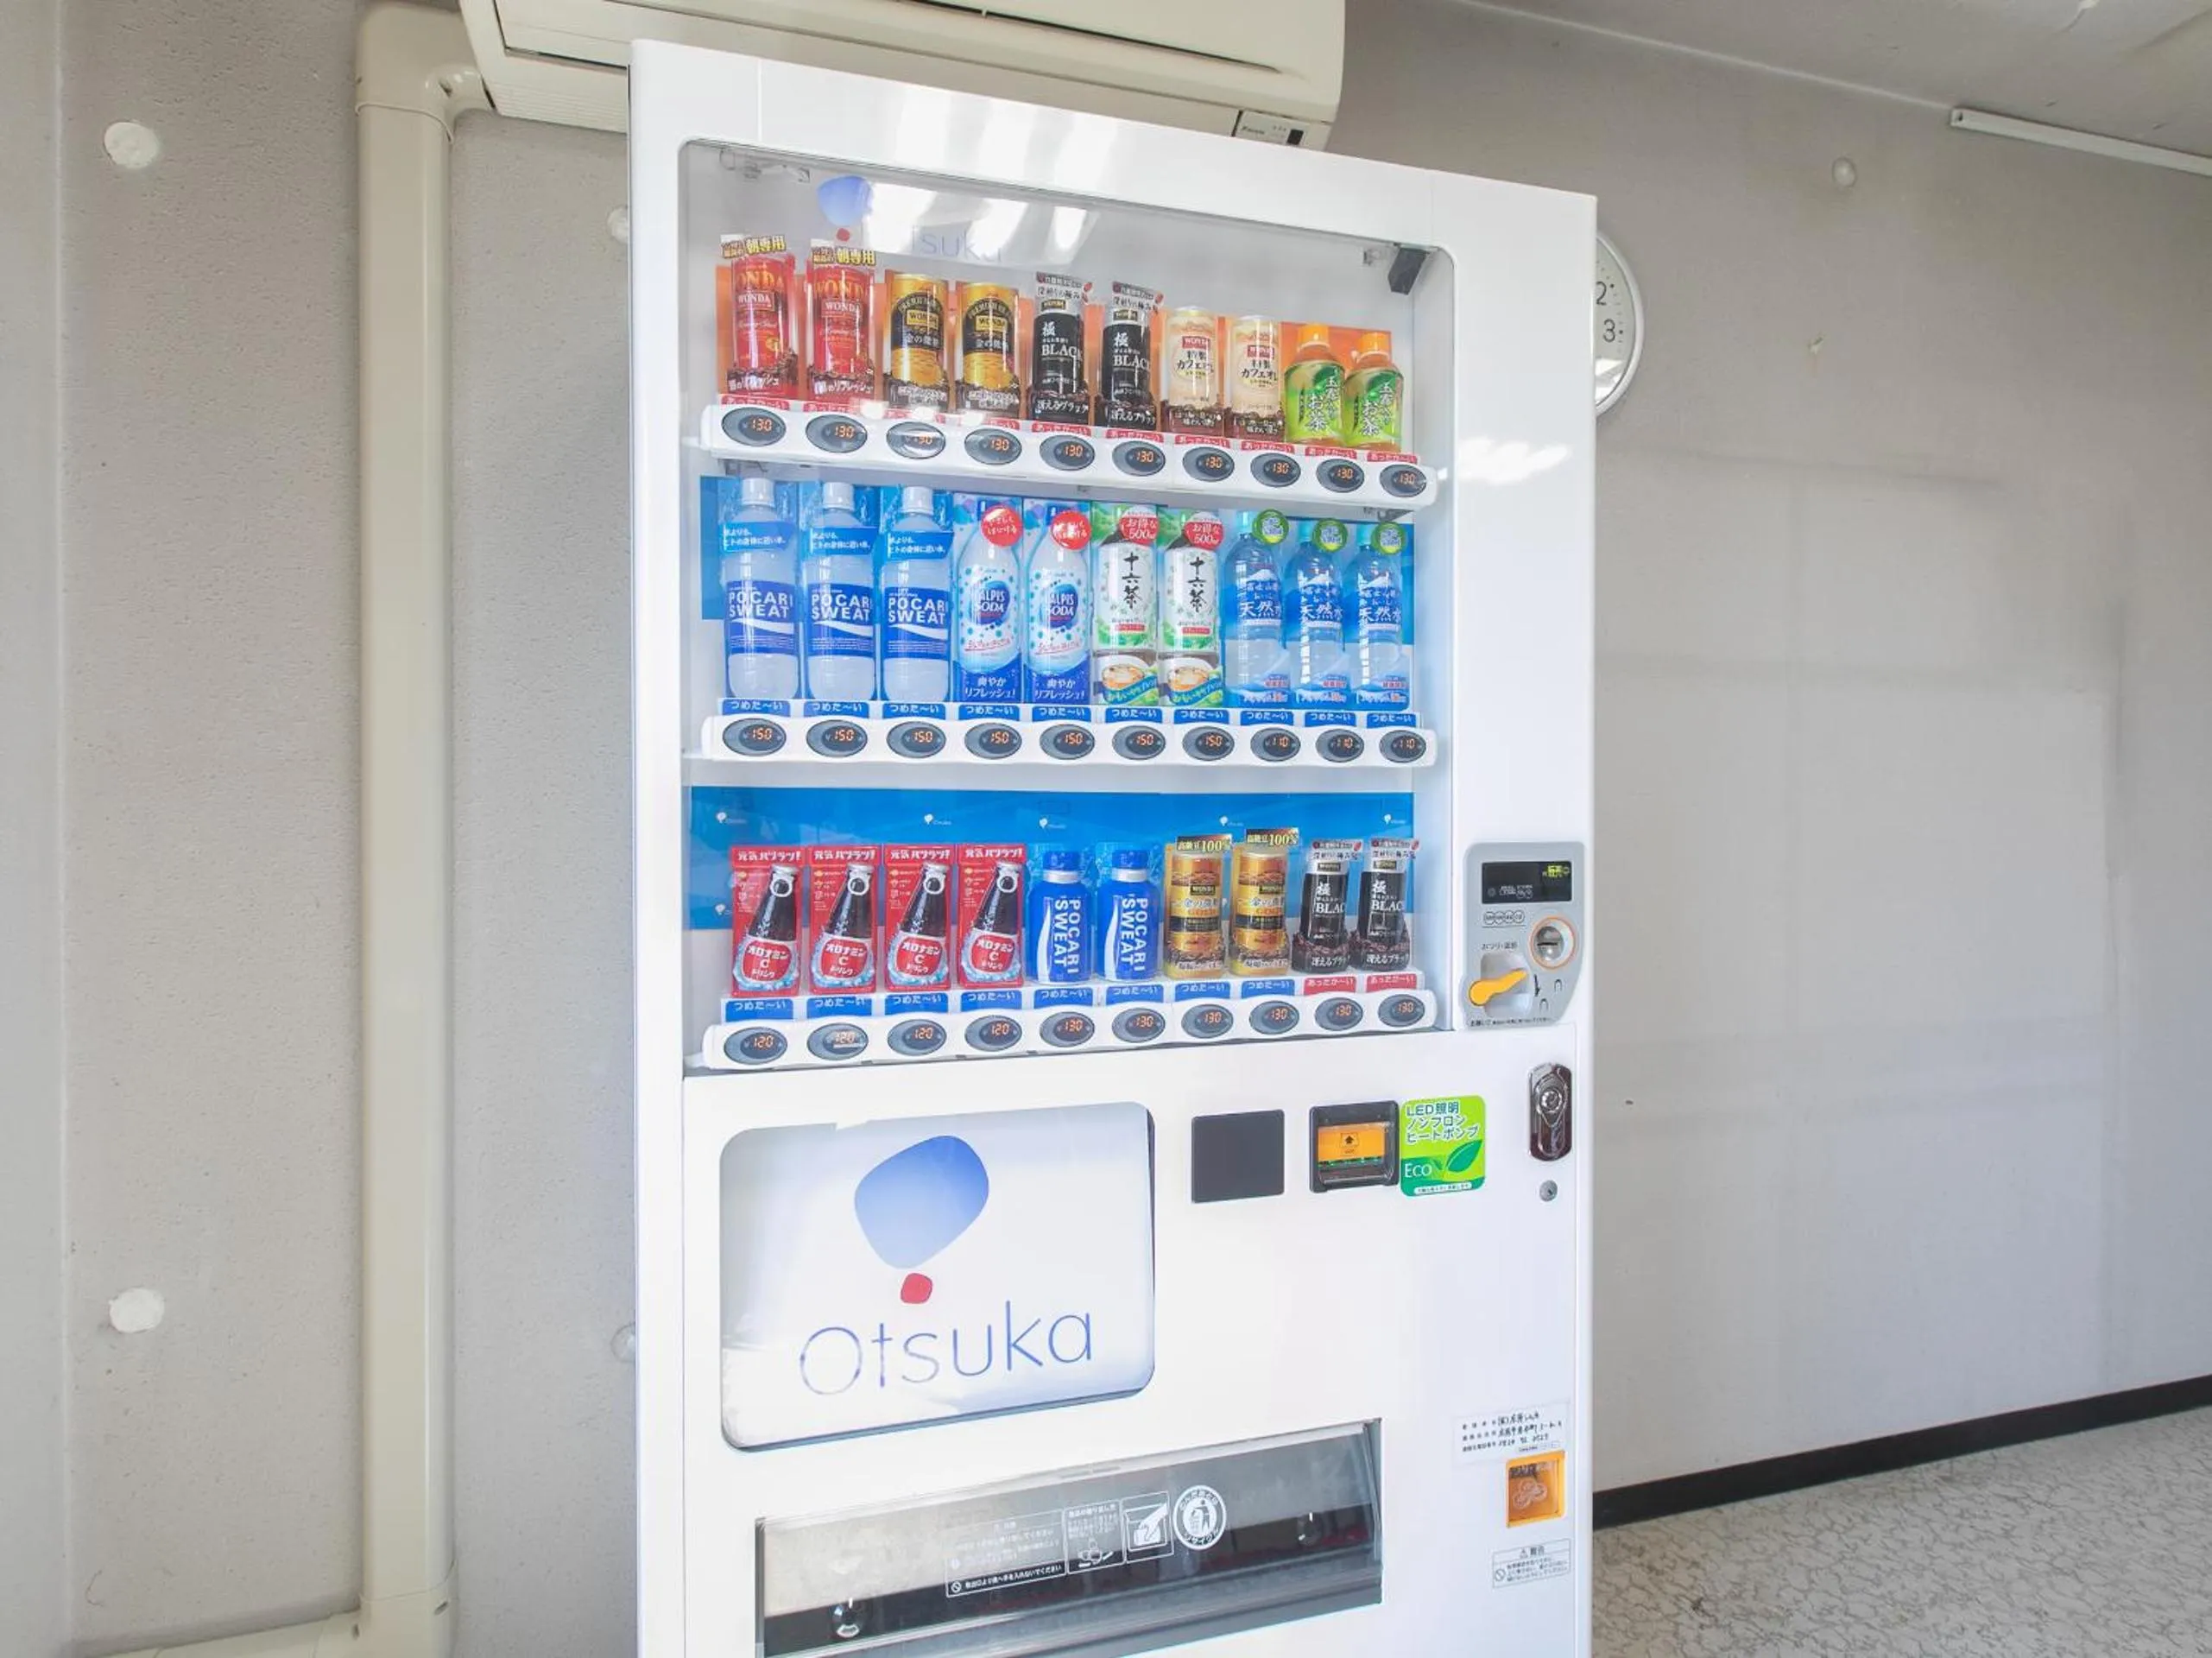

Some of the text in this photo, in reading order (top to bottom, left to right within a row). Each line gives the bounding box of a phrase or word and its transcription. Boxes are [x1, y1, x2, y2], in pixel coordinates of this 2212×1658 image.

[1596, 281, 1607, 306] 2
[1603, 319, 1615, 342] 3
[1114, 354, 1149, 370] BLAC
[752, 416, 772, 431] 130
[835, 426, 856, 439] 130
[991, 438, 1009, 451] 130
[1064, 445, 1083, 457] 130
[1136, 451, 1154, 463] 130
[1205, 457, 1223, 469] 130
[1273, 462, 1289, 474] 130
[1337, 469, 1353, 479] 130
[1400, 473, 1416, 484] 130
[1122, 552, 1142, 609] 十六茶
[1188, 557, 1208, 612] 十六茶
[729, 591, 793, 606] POCARI
[812, 592, 872, 609] POCARI
[978, 590, 1005, 603] ALPIS
[1047, 592, 1074, 604] ALPIS
[729, 604, 789, 618] SWEAT
[888, 597, 948, 613] POCARI
[812, 606, 870, 622] SWEAT
[888, 610, 946, 624] SWEAT
[752, 729, 772, 741] 150
[834, 729, 855, 742] 150
[913, 731, 933, 743] 150
[991, 733, 1009, 744] 150
[1065, 733, 1084, 745] 150
[1136, 735, 1154, 746] 150
[1205, 735, 1223, 747] 150
[1315, 902, 1345, 914] BLAC
[1371, 900, 1405, 912] BLAC
[1054, 898, 1068, 967] SWEAT
[1066, 897, 1081, 974] POCARI
[1121, 897, 1135, 965] SWEAT
[1134, 897, 1148, 972] POCARI
[825, 944, 865, 959] オロナミン
[902, 942, 940, 957] オロナミン
[976, 939, 1014, 954] オロナミン
[748, 946, 790, 961] オロナミン
[914, 954, 925, 965] C
[989, 951, 999, 961] C
[760, 959, 771, 969] C
[838, 956, 849, 966] C
[1336, 1004, 1352, 1016] 130
[1398, 1001, 1414, 1013] 130
[1204, 1011, 1223, 1023] 130
[1271, 1008, 1288, 1020] 130
[991, 1022, 1011, 1035] 120
[1065, 1019, 1083, 1033] 130
[1136, 1016, 1154, 1028] 130
[913, 1026, 934, 1040] 120
[752, 1035, 774, 1049] 120
[1406, 1101, 1460, 1117] LED照明
[1407, 1115, 1467, 1130] ノンフロン
[1406, 1123, 1480, 1143] ヒートポンプ
